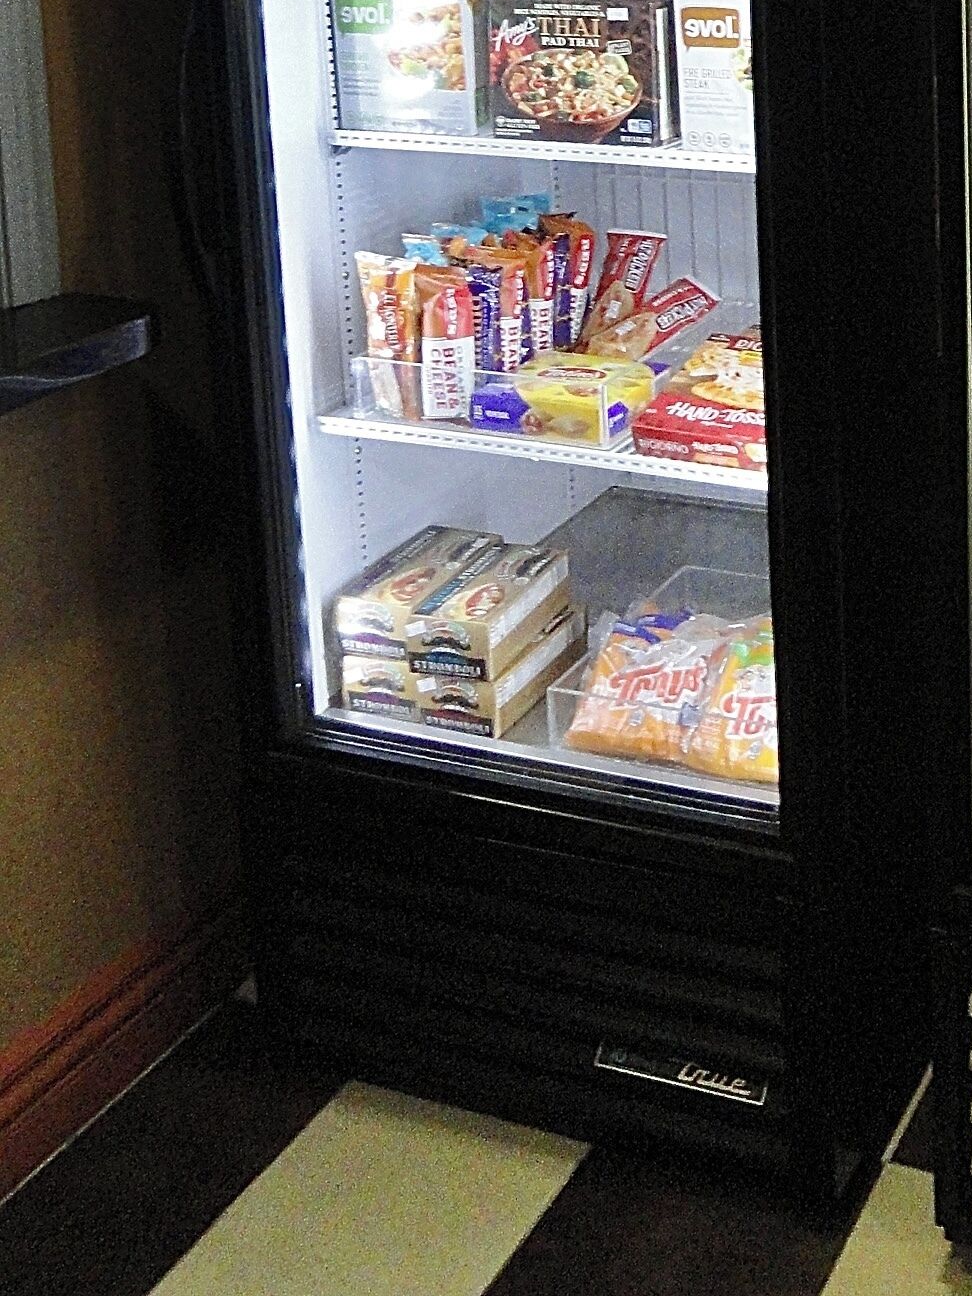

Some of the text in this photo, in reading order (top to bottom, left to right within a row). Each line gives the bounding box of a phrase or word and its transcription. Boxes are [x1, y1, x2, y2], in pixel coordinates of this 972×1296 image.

[491, 16, 539, 52] Amy's
[537, 16, 602, 38] THAI
[541, 36, 567, 47] PAD
[568, 37, 600, 48] THAI
[442, 347, 459, 395] BEAN
